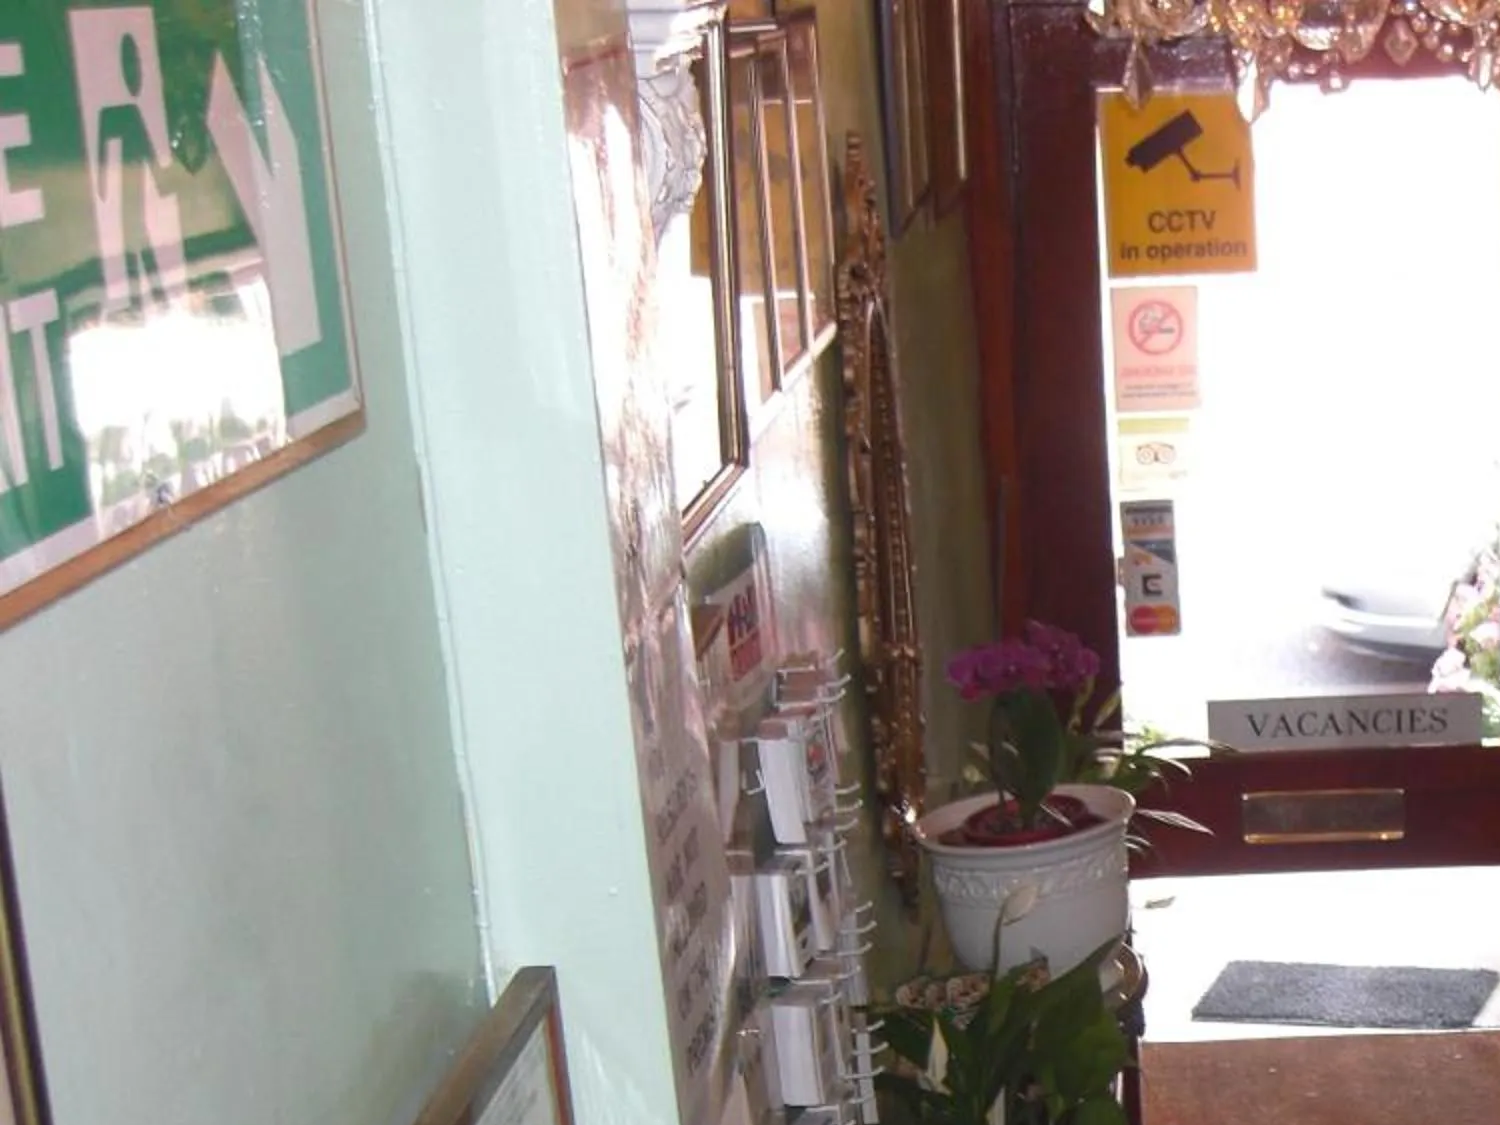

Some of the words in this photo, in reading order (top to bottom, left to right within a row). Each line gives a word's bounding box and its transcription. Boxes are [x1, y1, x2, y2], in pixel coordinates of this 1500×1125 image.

[1148, 210, 1217, 234] CCTV
[1120, 242, 1139, 260] in
[1146, 239, 1248, 263] operation
[1247, 708, 1449, 738] VACANCIES
